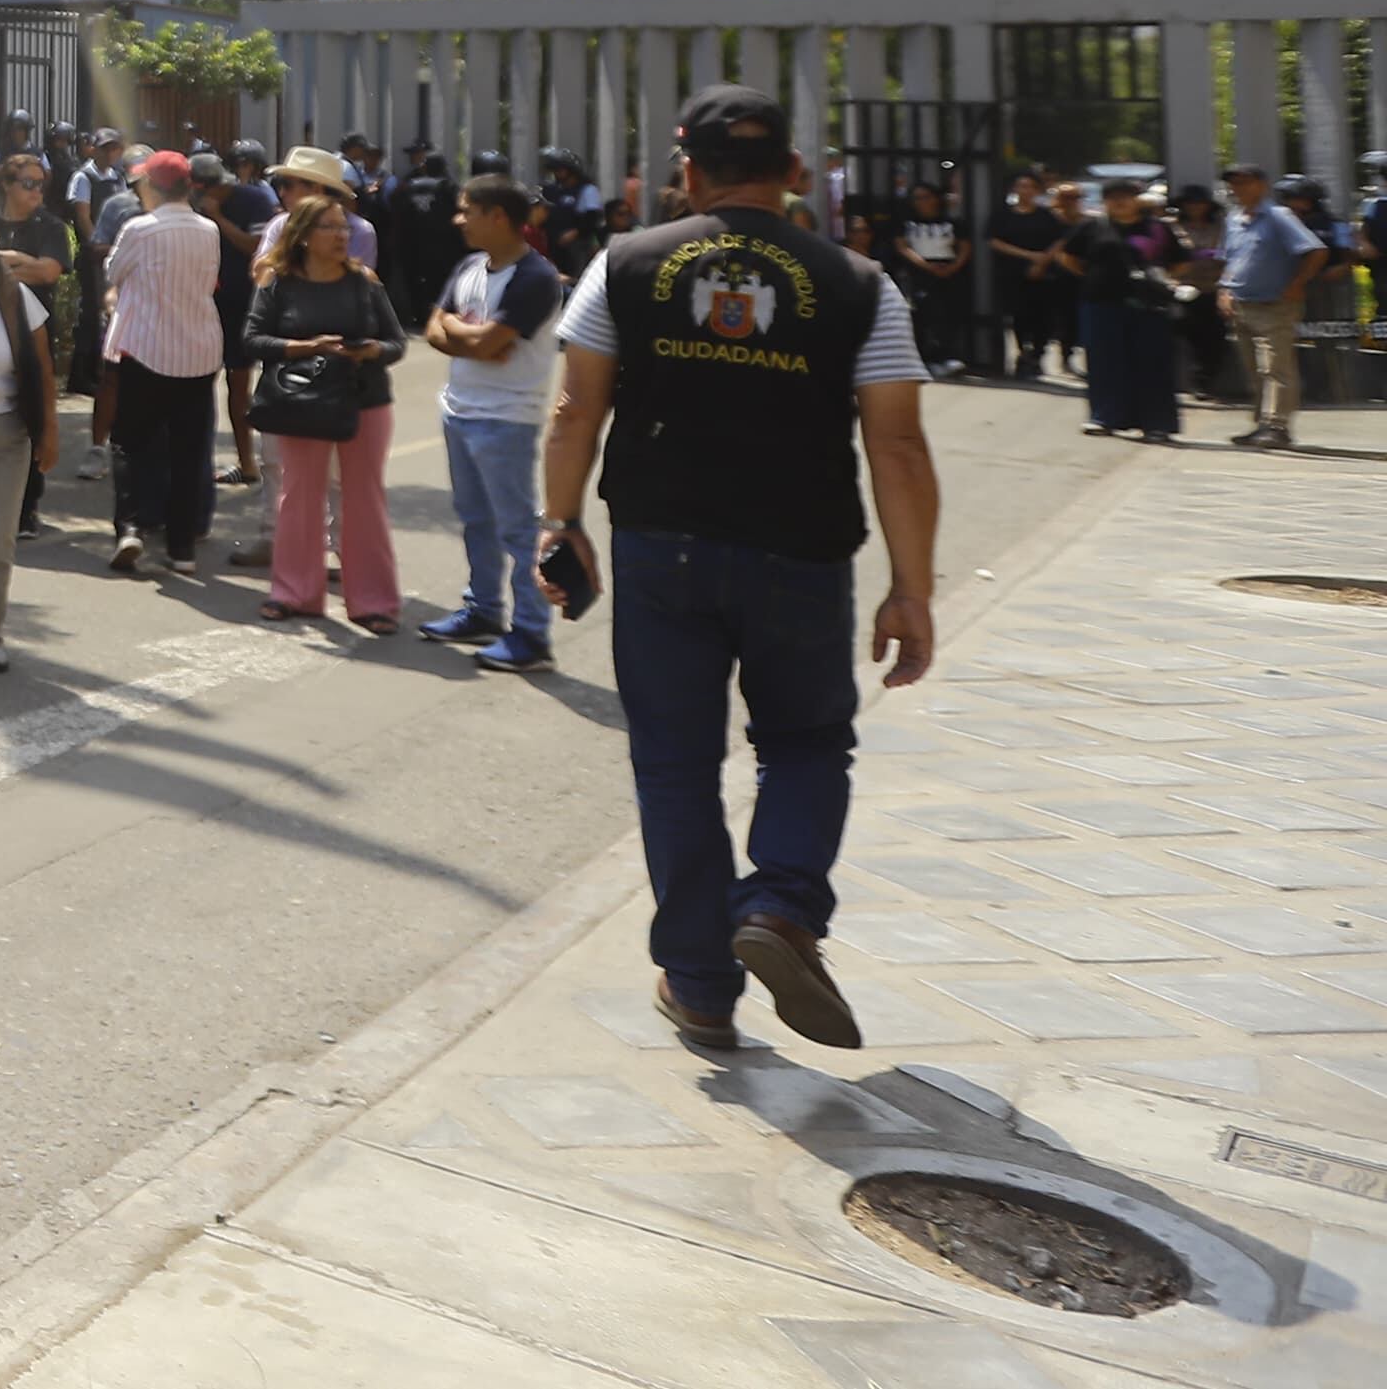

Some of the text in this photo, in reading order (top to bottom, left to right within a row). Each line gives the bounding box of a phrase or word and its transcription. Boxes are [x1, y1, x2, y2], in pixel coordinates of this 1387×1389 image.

[654, 232, 818, 319] GERENCIA DE SEGURIDAD
[654, 337, 810, 373] CIUDADANA
